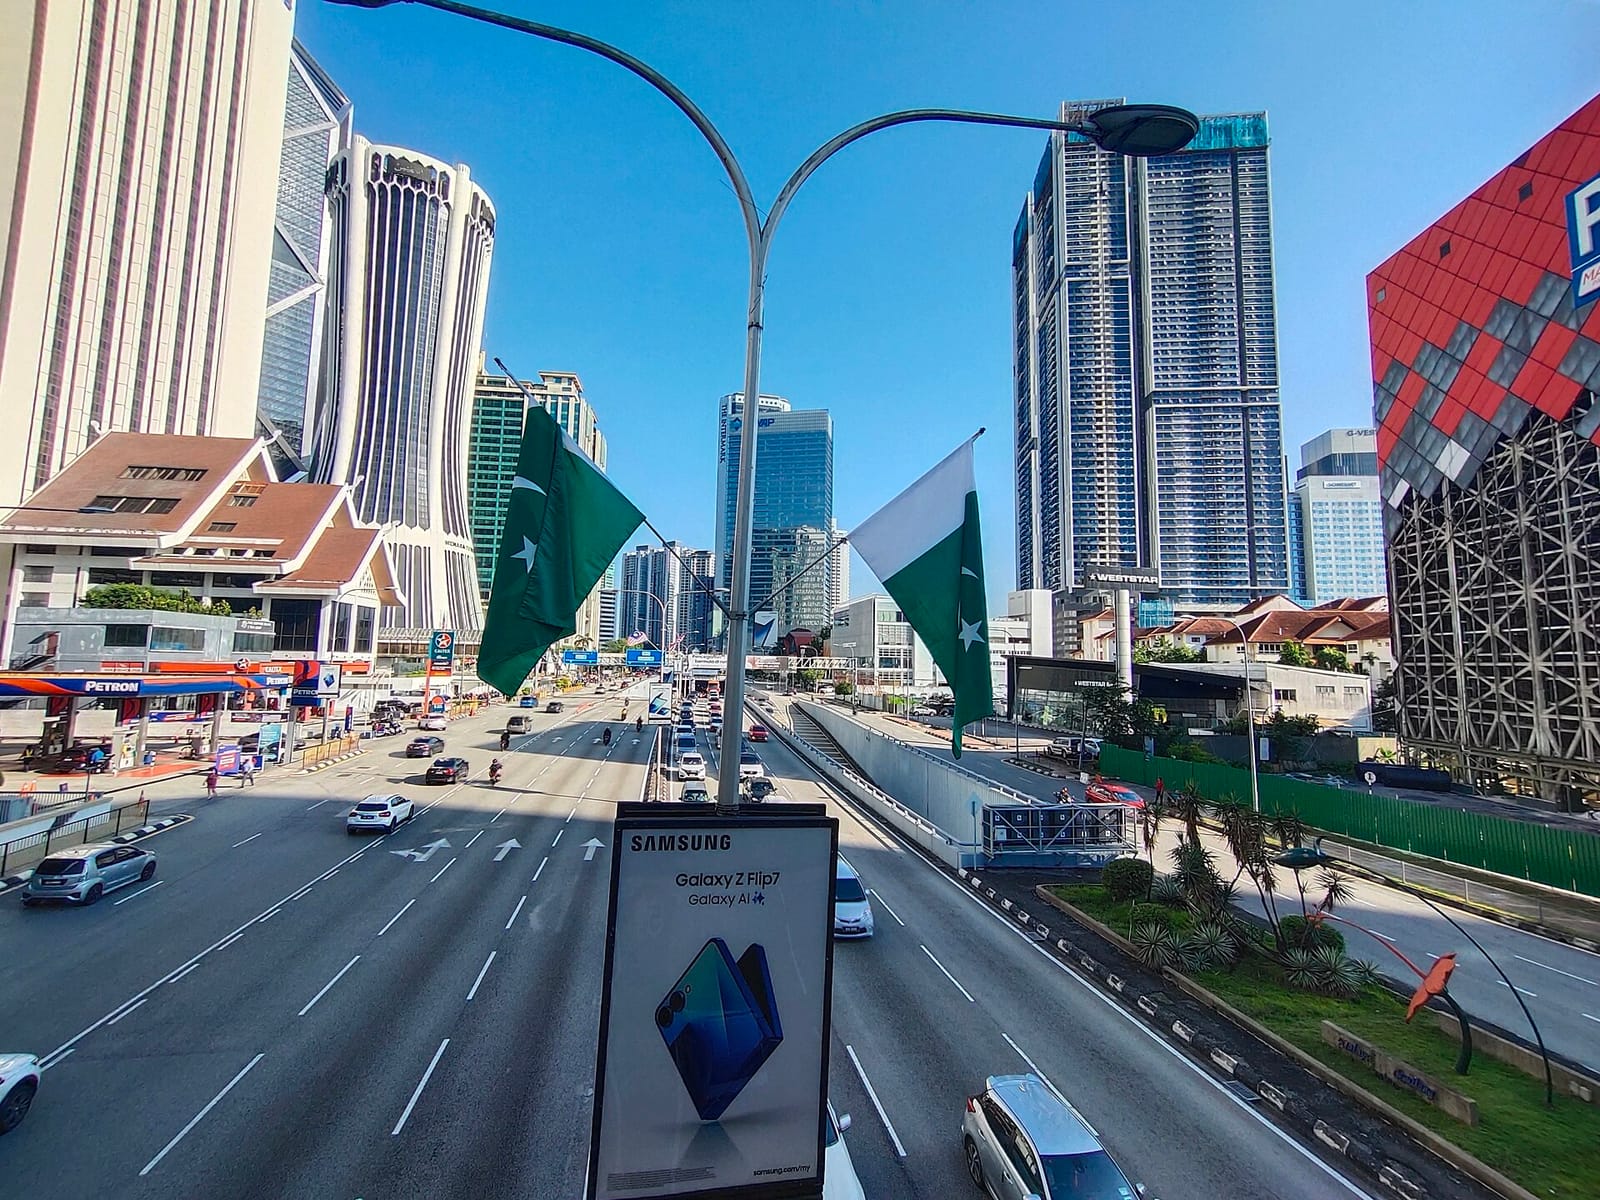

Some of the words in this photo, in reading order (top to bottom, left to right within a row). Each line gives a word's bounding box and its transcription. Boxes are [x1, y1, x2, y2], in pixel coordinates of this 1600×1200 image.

[1097, 574, 1158, 583] WESTSTAR
[85, 681, 139, 692] PETRON
[631, 834, 731, 851] SAMSUNG
[675, 873, 733, 889] Galaxy
[735, 872, 744, 886] Z
[747, 871, 780, 889] Flip7
[688, 893, 736, 908] Galaxy
[738, 893, 750, 905] AI
[753, 1165, 811, 1176] samsung.com/my
